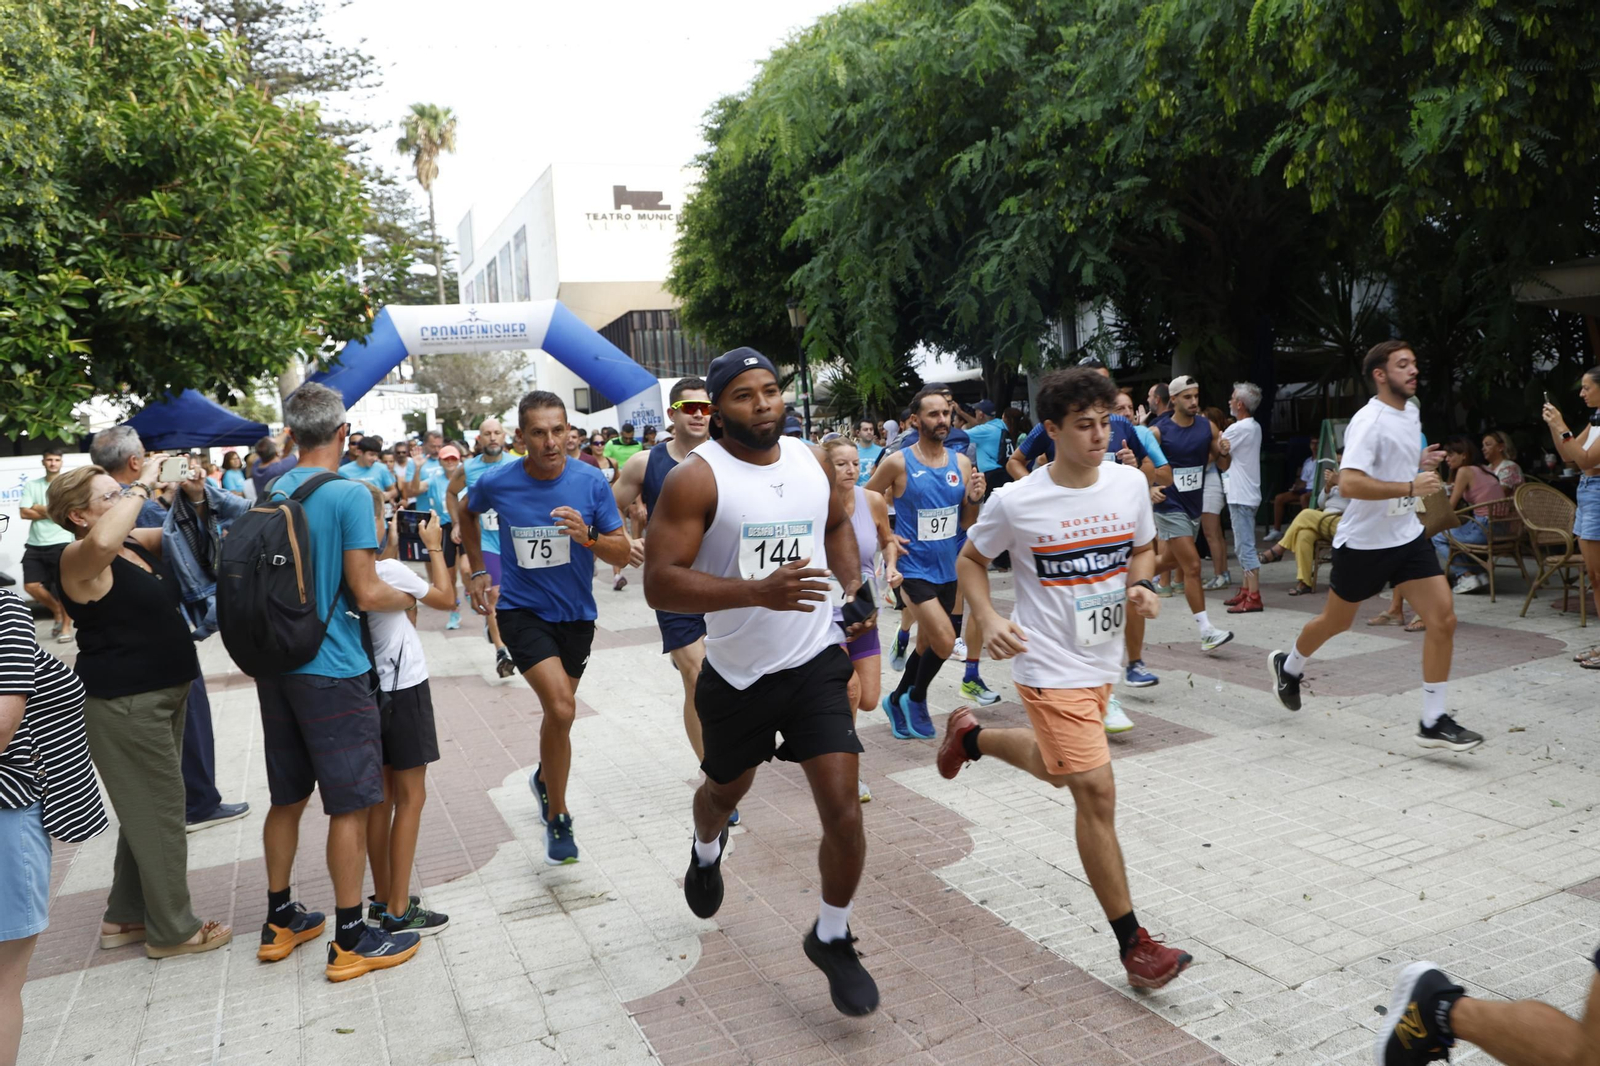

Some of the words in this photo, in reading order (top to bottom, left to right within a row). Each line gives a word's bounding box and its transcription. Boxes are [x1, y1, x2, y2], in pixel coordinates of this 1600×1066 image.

[586, 213, 631, 221] TEATRO
[638, 213, 683, 221] MUNICI
[421, 323, 528, 340] CRONOFINISHER
[381, 396, 435, 411] TURISMO
[632, 409, 655, 418] CRONO
[1180, 474, 1198, 487] 154
[931, 517, 947, 534] 97
[1060, 513, 1120, 528] HOSTAL
[1037, 535, 1056, 544] EL
[528, 539, 552, 560] 75
[755, 538, 801, 569] 144
[1088, 603, 1123, 635] 180
